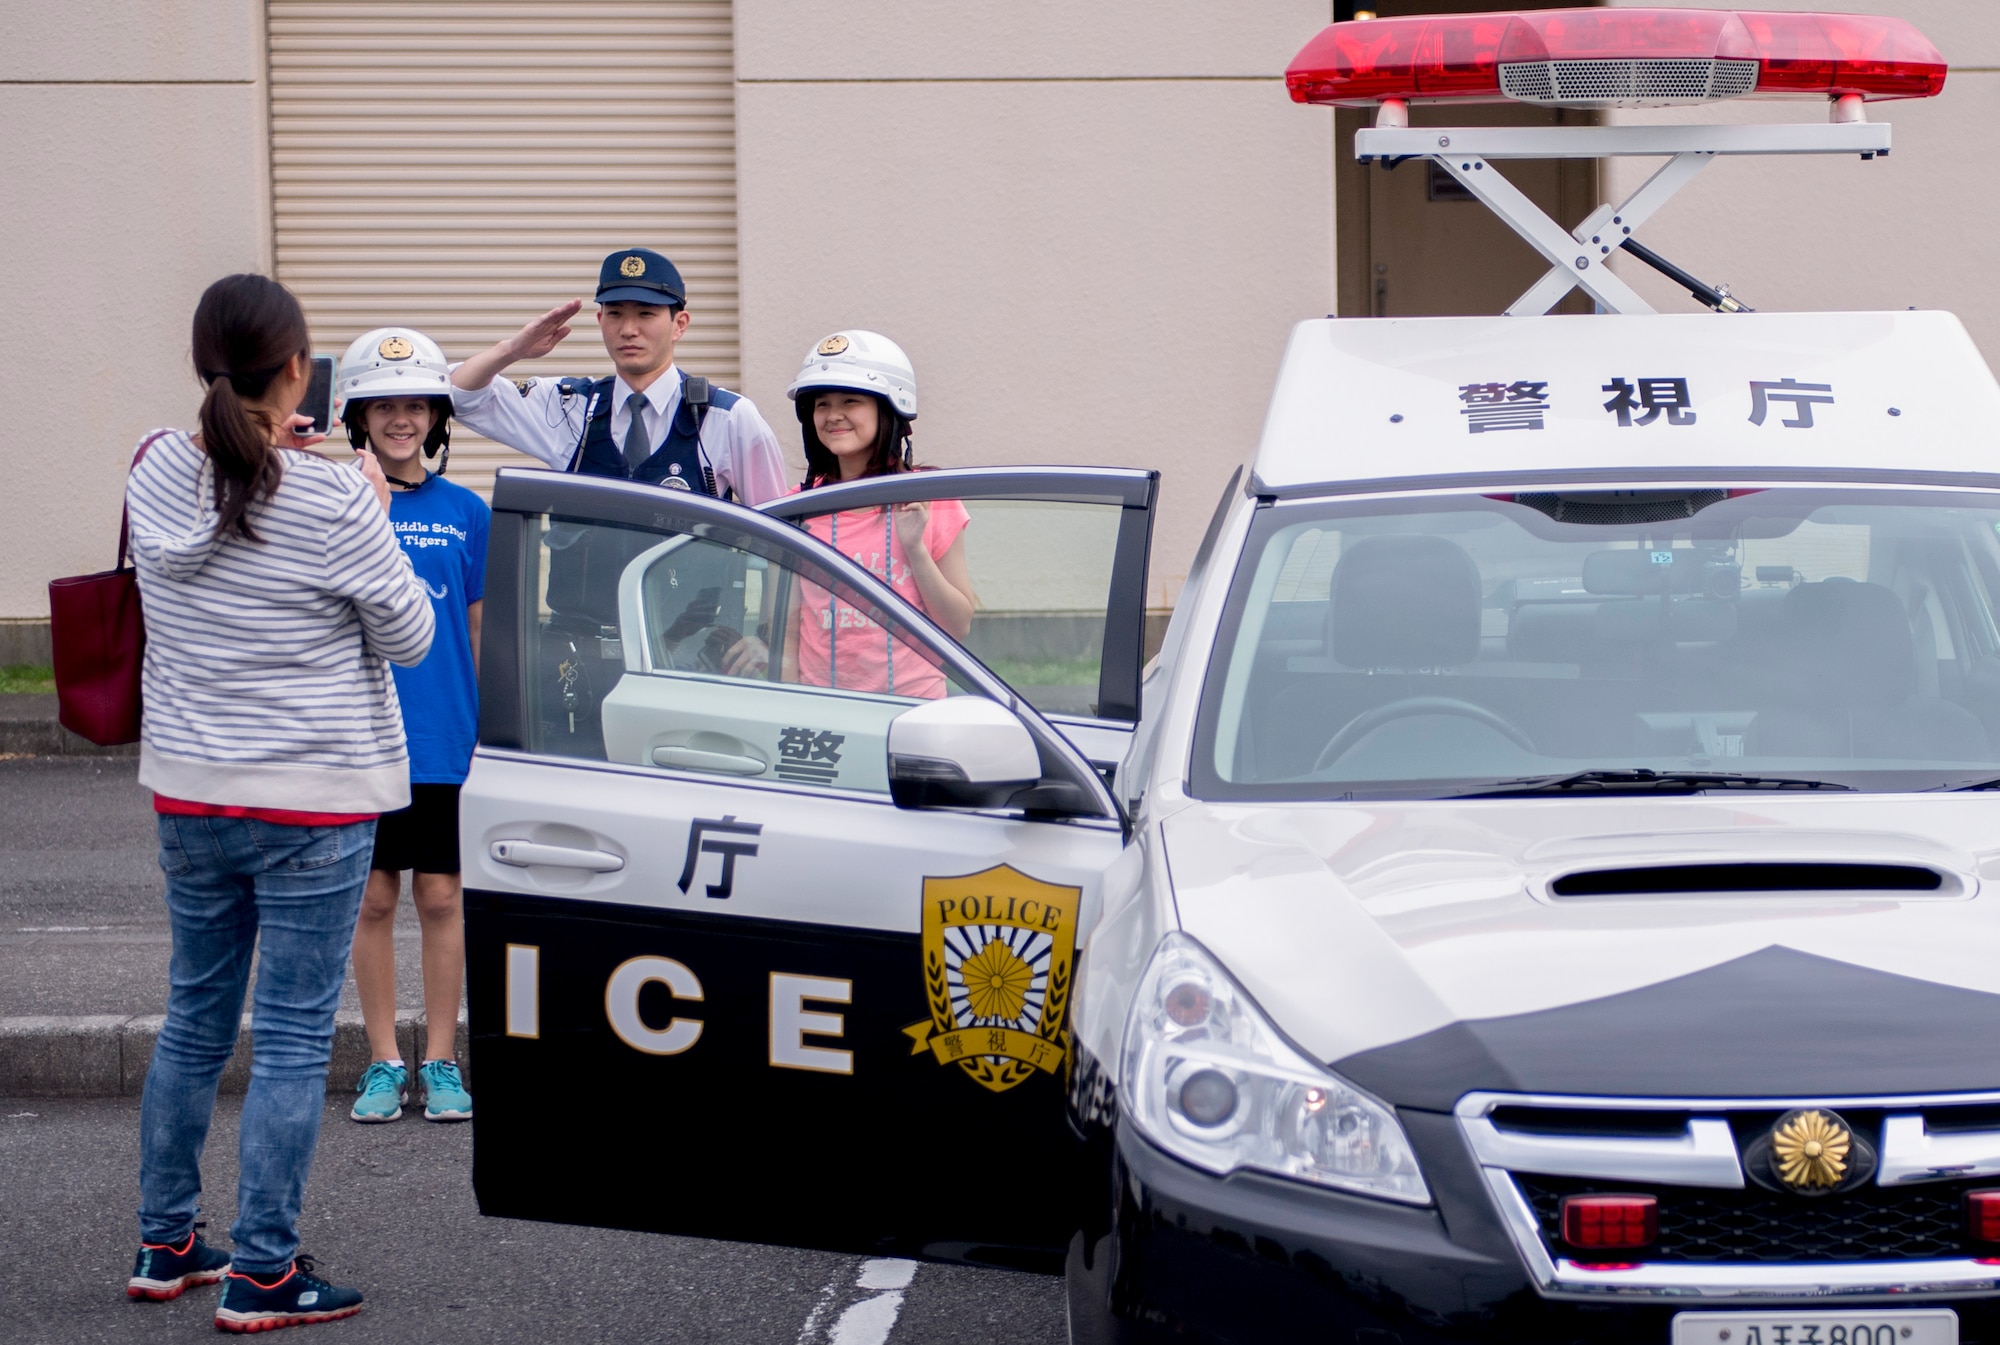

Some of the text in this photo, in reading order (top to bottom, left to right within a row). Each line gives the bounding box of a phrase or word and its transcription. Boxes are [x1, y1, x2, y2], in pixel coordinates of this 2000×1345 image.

[1459, 377, 1834, 434] 警視庁
[404, 535, 448, 548] Tigers
[774, 727, 845, 786] 警
[677, 815, 763, 899] 庁
[937, 895, 1062, 932] POLICE
[506, 943, 853, 1075] ICE
[943, 1029, 1051, 1064] 警視庁
